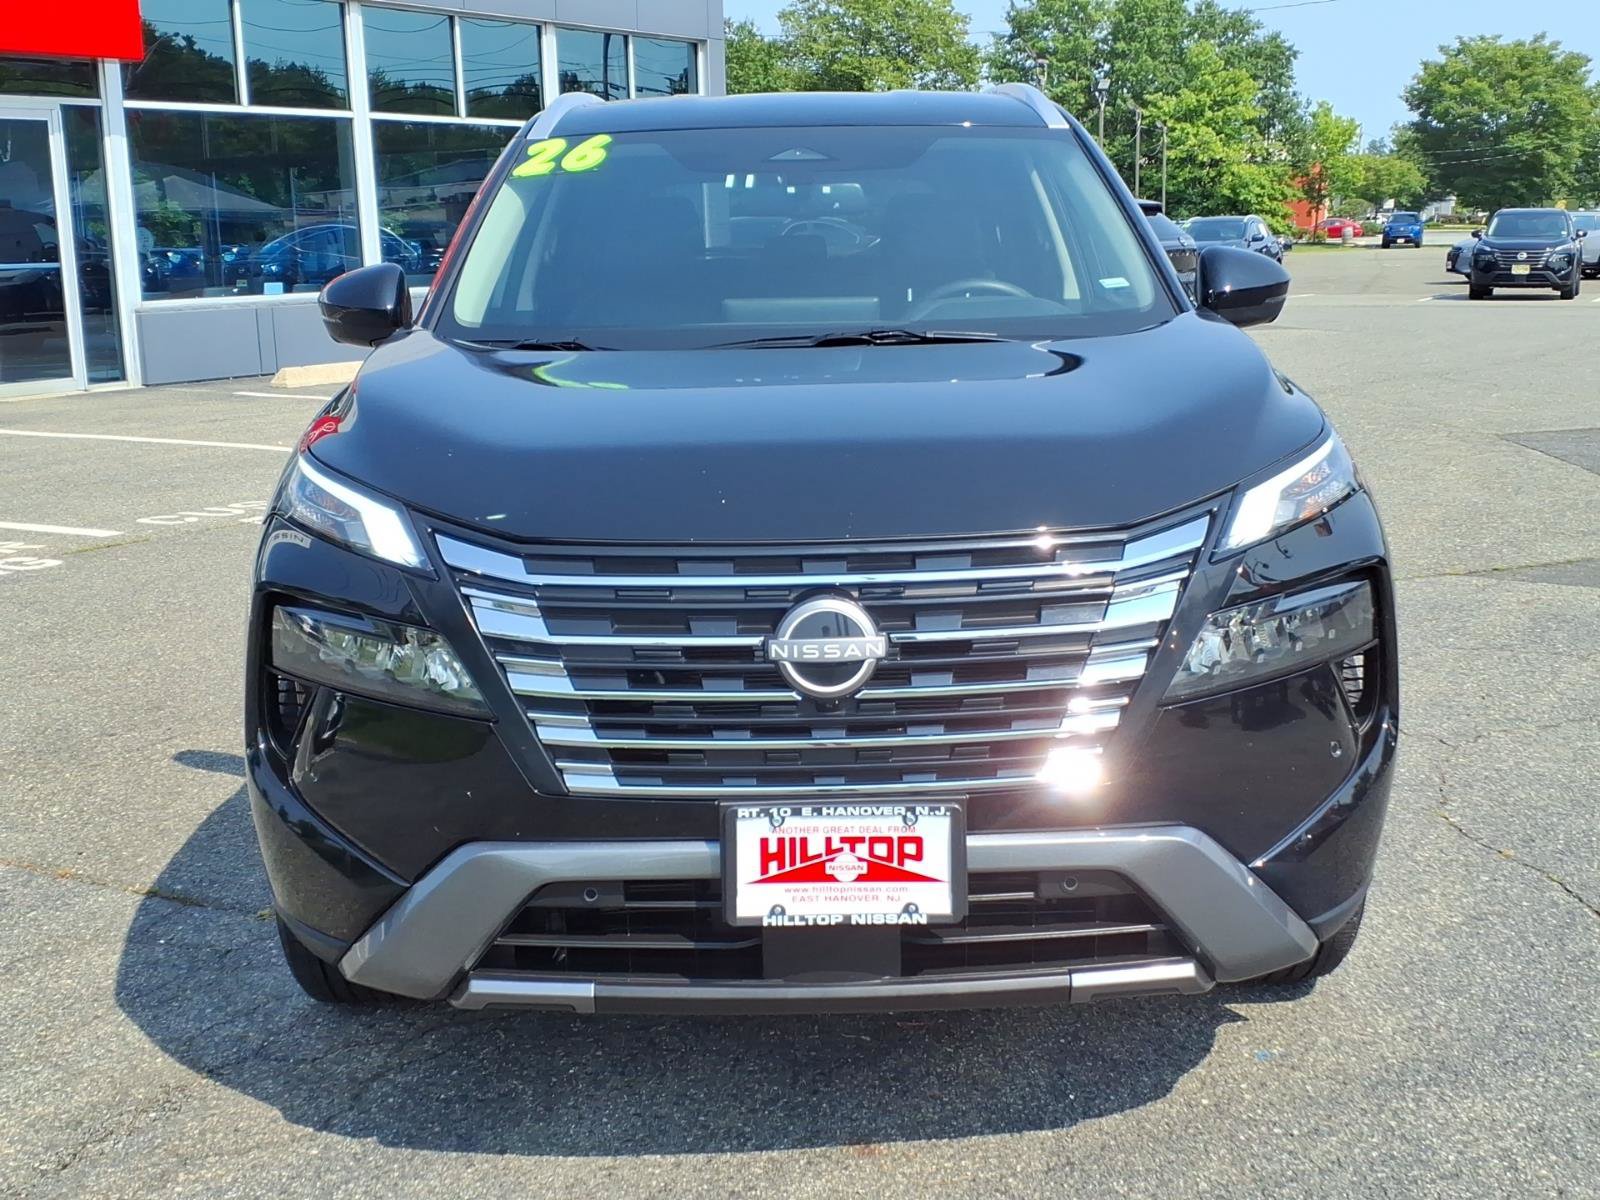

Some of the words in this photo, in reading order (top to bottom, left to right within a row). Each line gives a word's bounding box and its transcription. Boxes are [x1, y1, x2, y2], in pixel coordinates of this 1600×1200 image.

[512, 134, 613, 177] 26
[771, 642, 883, 659] NISSAN
[737, 807, 765, 818] RT.
[769, 807, 792, 818] 10
[801, 806, 818, 817] E.
[915, 806, 951, 816] N.J.
[771, 826, 819, 834] ANOTHER
[823, 826, 855, 834] GREAT
[859, 825, 884, 834] DEAL
[888, 825, 916, 833] FROM
[760, 836, 924, 876] HILLTOP
[784, 885, 909, 894] www.hilltopnissan.com
[887, 894, 901, 902] NJ
[762, 914, 844, 927] HILLTOP
[850, 913, 928, 926] NISSAN
